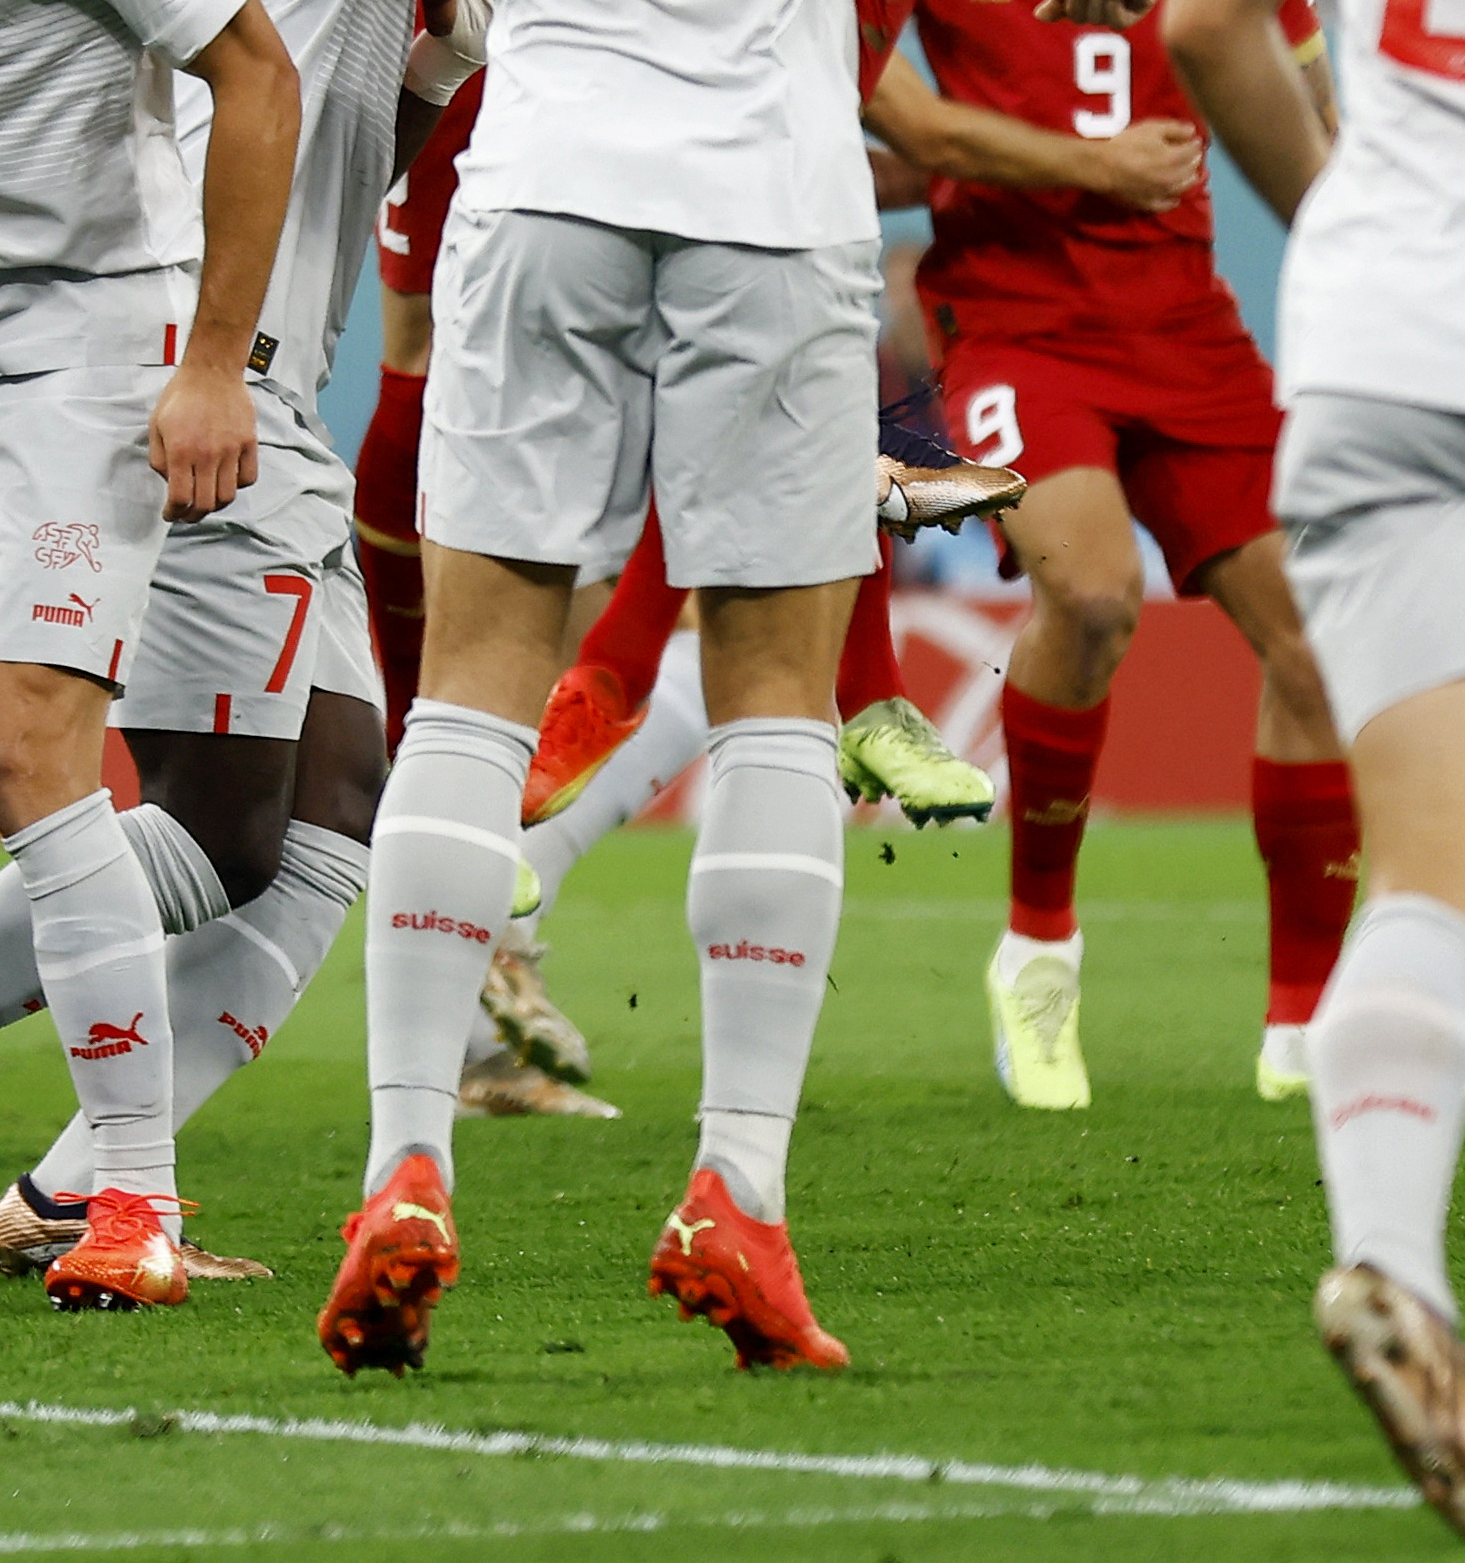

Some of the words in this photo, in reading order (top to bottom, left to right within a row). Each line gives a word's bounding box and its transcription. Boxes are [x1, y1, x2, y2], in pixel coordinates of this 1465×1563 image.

[1073, 32, 1132, 139] 9
[967, 384, 1025, 469] 9
[32, 603, 85, 628] PUMA
[263, 574, 313, 694] 7
[391, 910, 492, 944] suisse
[707, 939, 806, 968] suisse
[70, 1039, 133, 1060] PUMA
